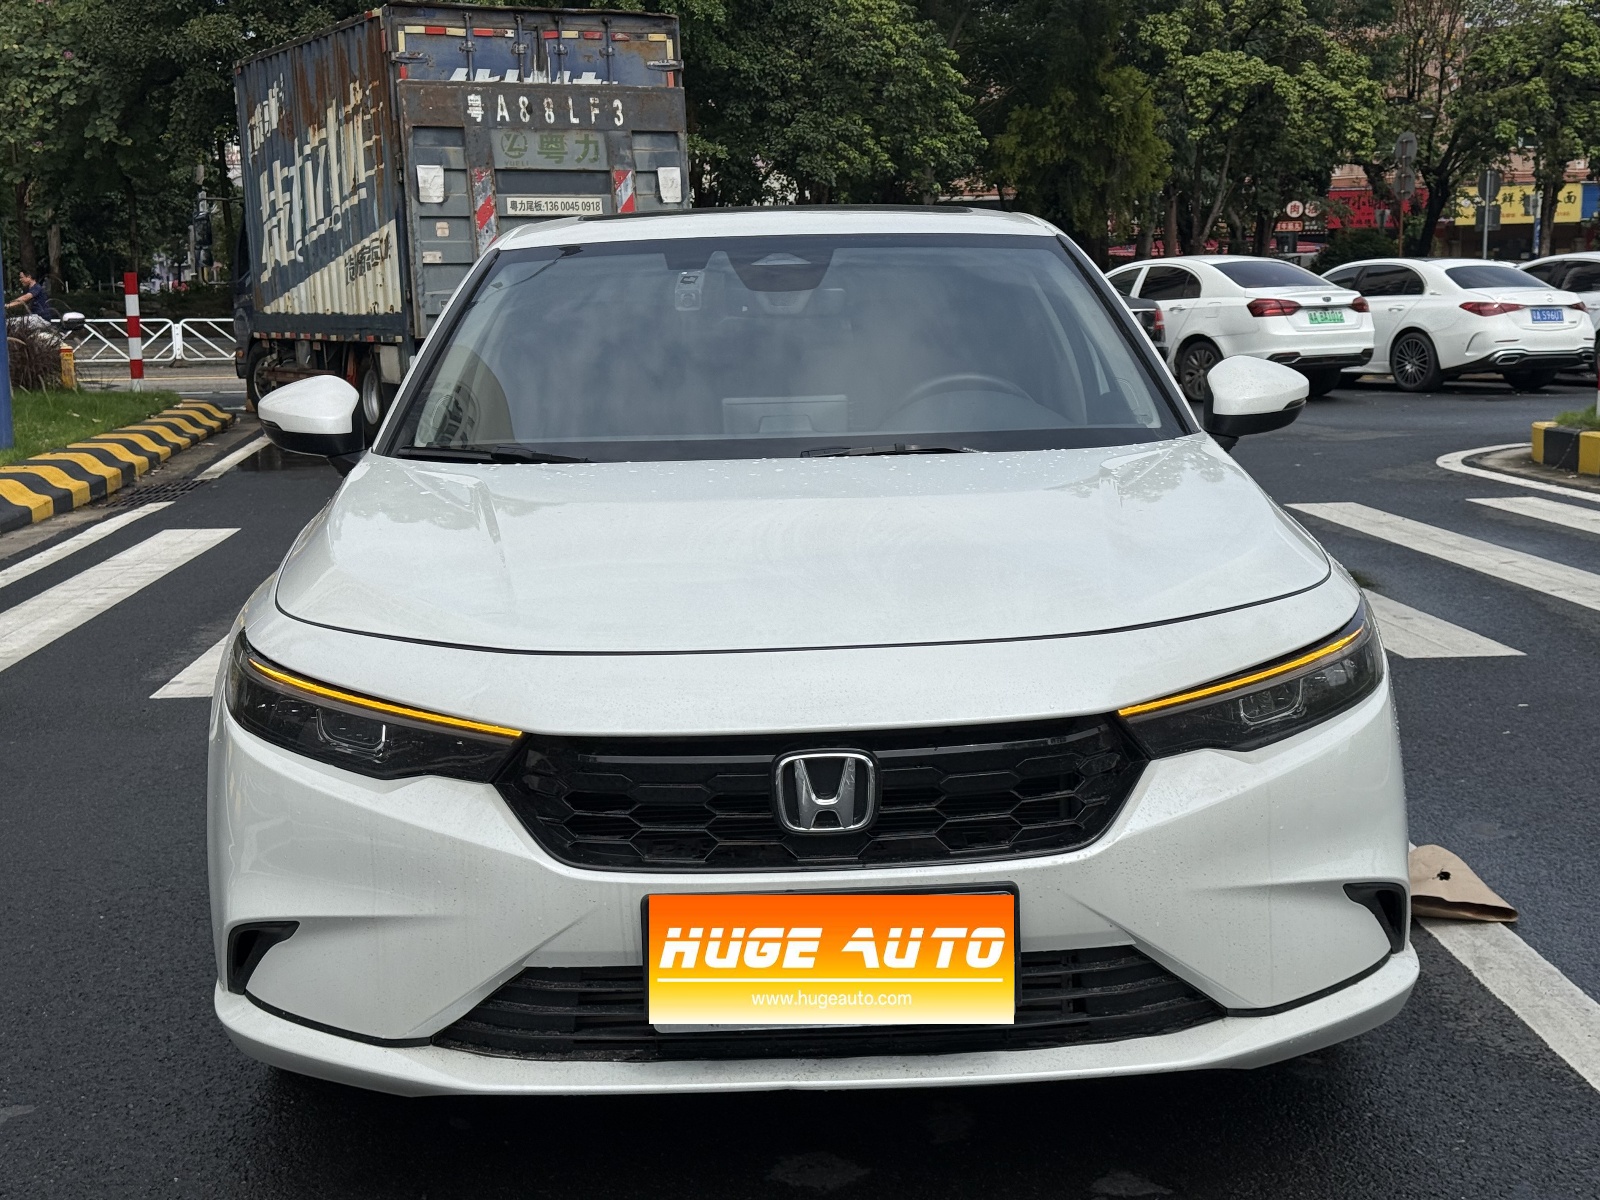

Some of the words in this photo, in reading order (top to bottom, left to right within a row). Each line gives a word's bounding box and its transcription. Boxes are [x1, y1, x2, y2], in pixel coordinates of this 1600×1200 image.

[537, 133, 599, 164] 粤力
[560, 201, 580, 212] 0045
[581, 201, 601, 212] 0918
